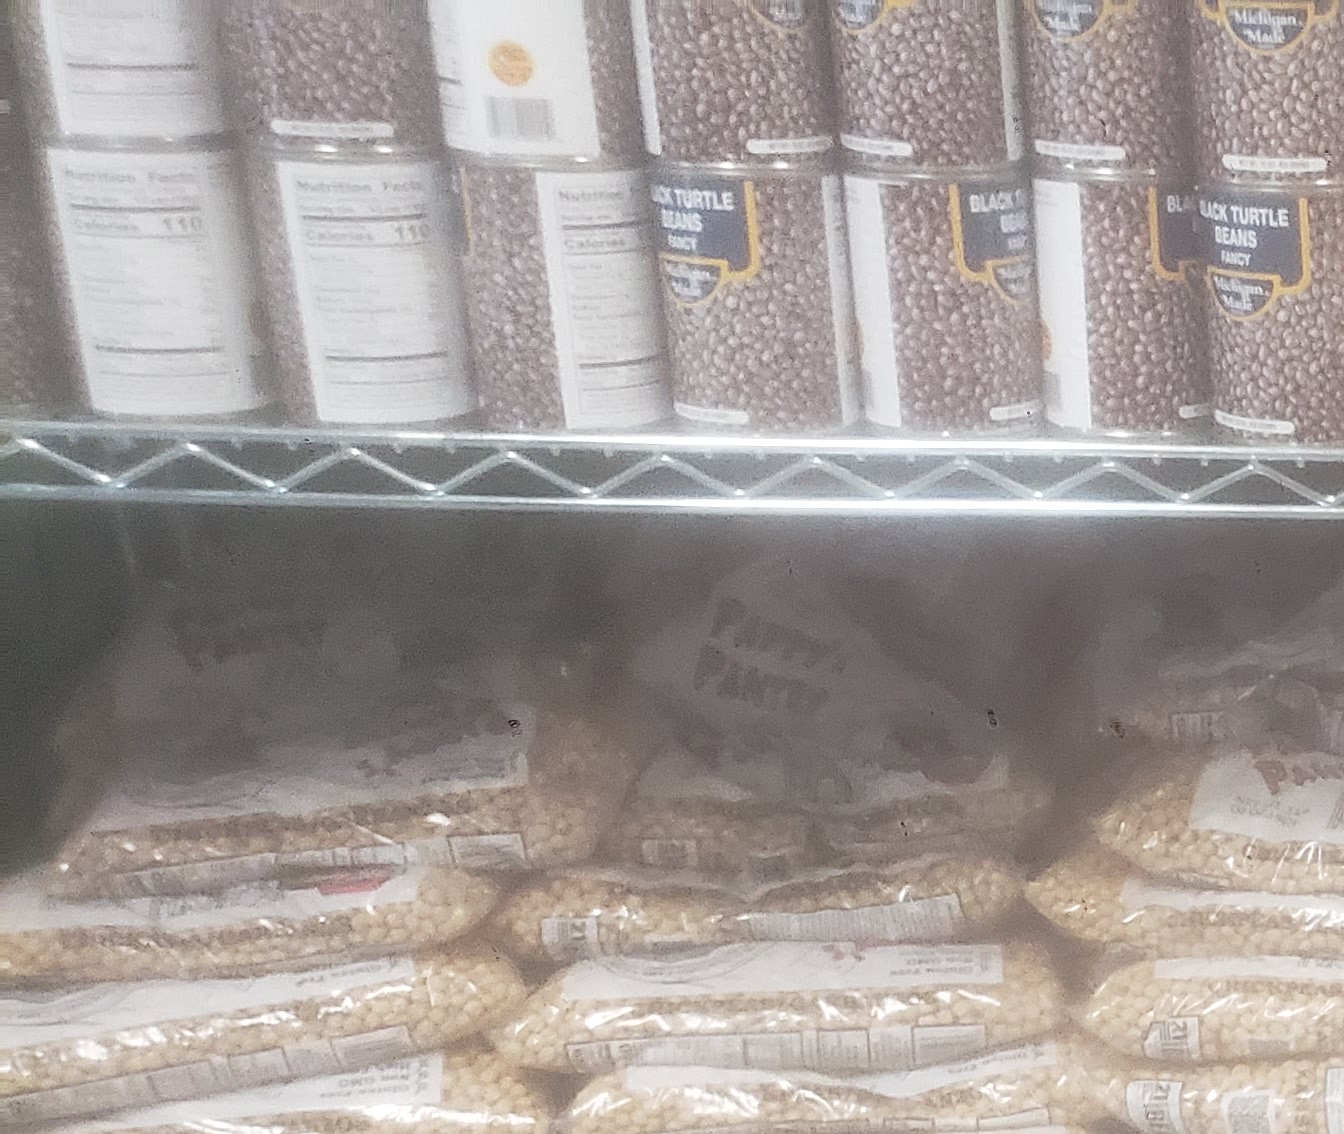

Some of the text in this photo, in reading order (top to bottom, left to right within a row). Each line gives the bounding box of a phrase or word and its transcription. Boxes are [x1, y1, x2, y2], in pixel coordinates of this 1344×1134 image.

[674, 188, 734, 211] TURTLE
[1229, 204, 1290, 229] TURTLE
[1213, 225, 1259, 249] BEANS
